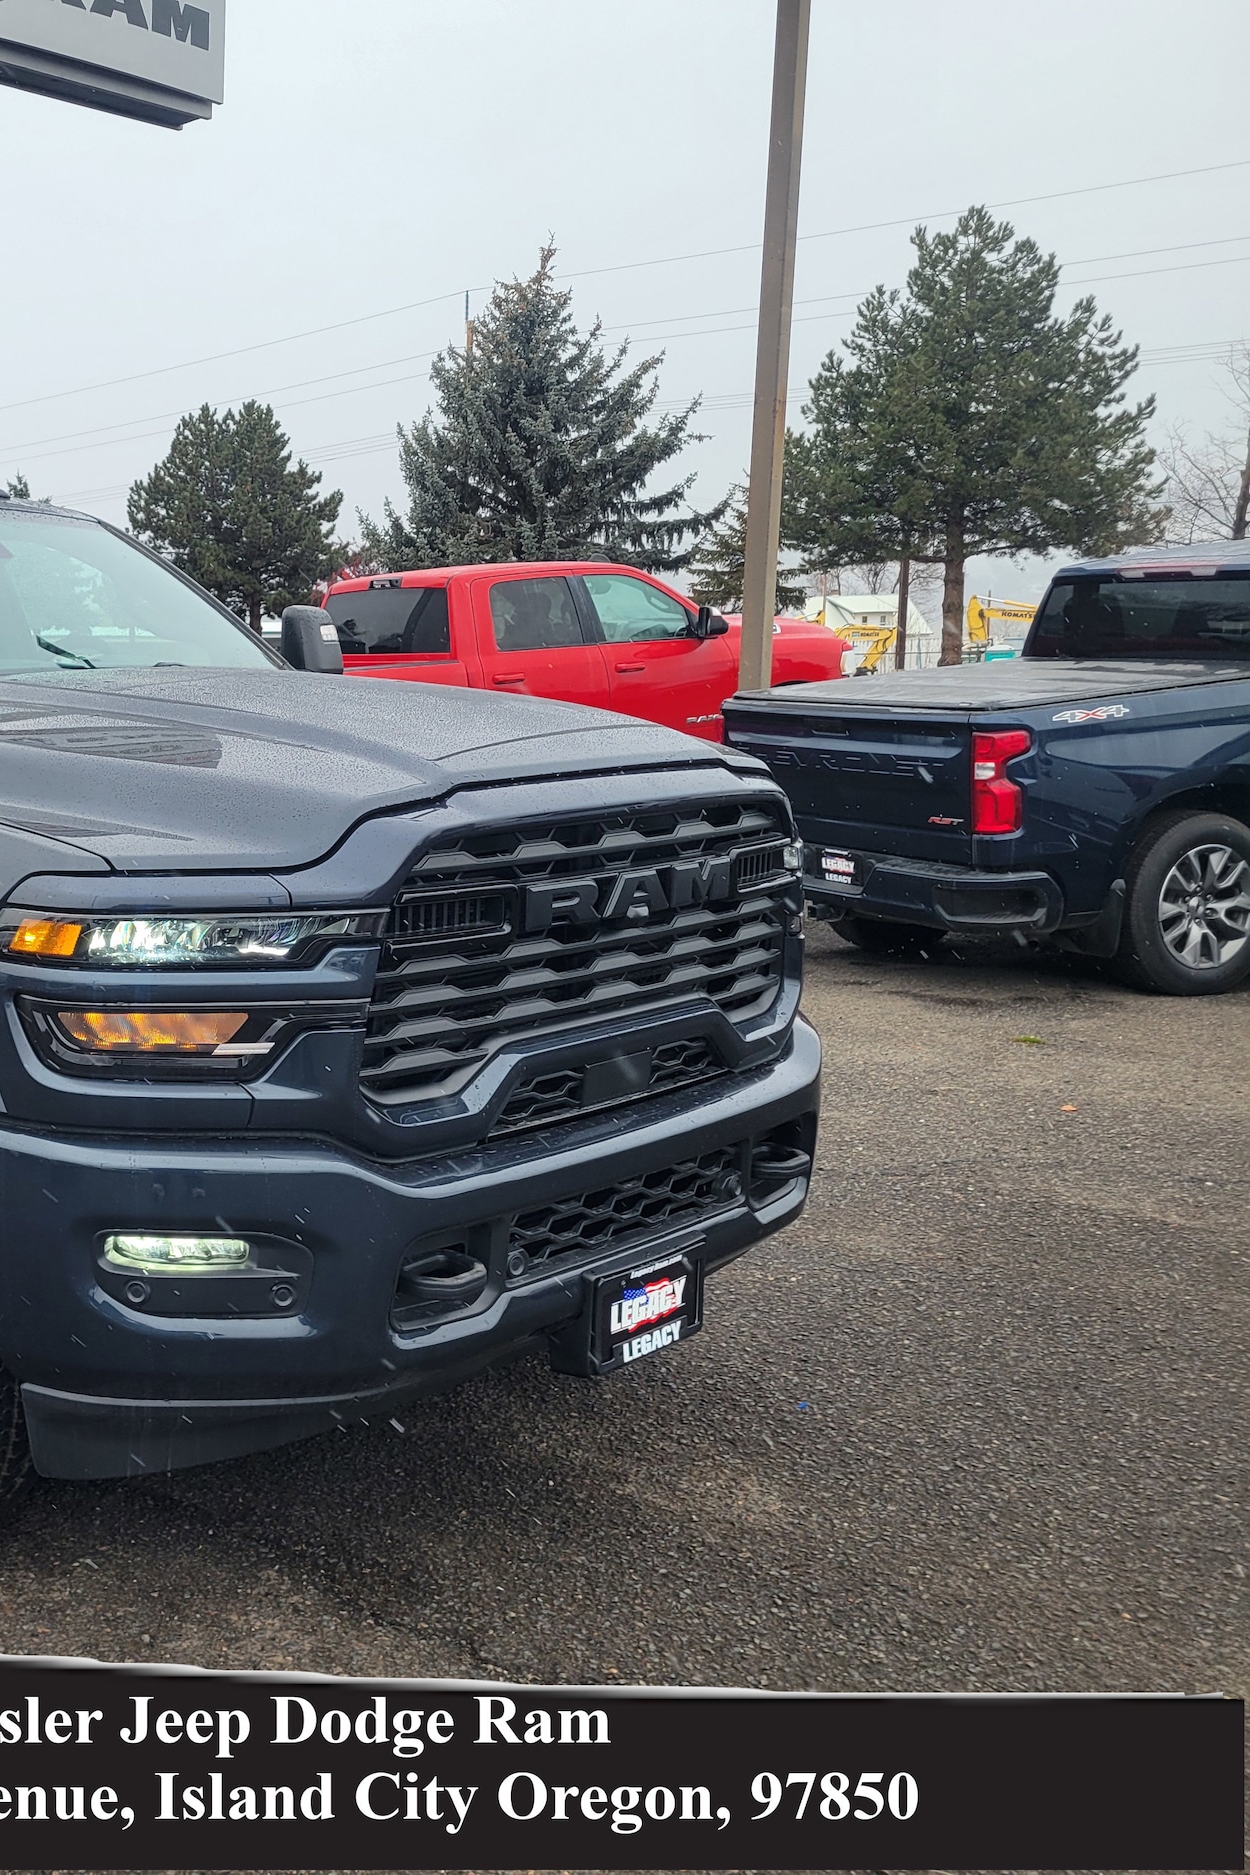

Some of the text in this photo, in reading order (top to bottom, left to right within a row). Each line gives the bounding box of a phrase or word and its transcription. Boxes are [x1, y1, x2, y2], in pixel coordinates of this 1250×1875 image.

[61, 0, 210, 51] AM
[526, 856, 731, 932] RAM
[610, 1277, 687, 1332] LEGACY
[623, 1320, 681, 1363] LEGACY
